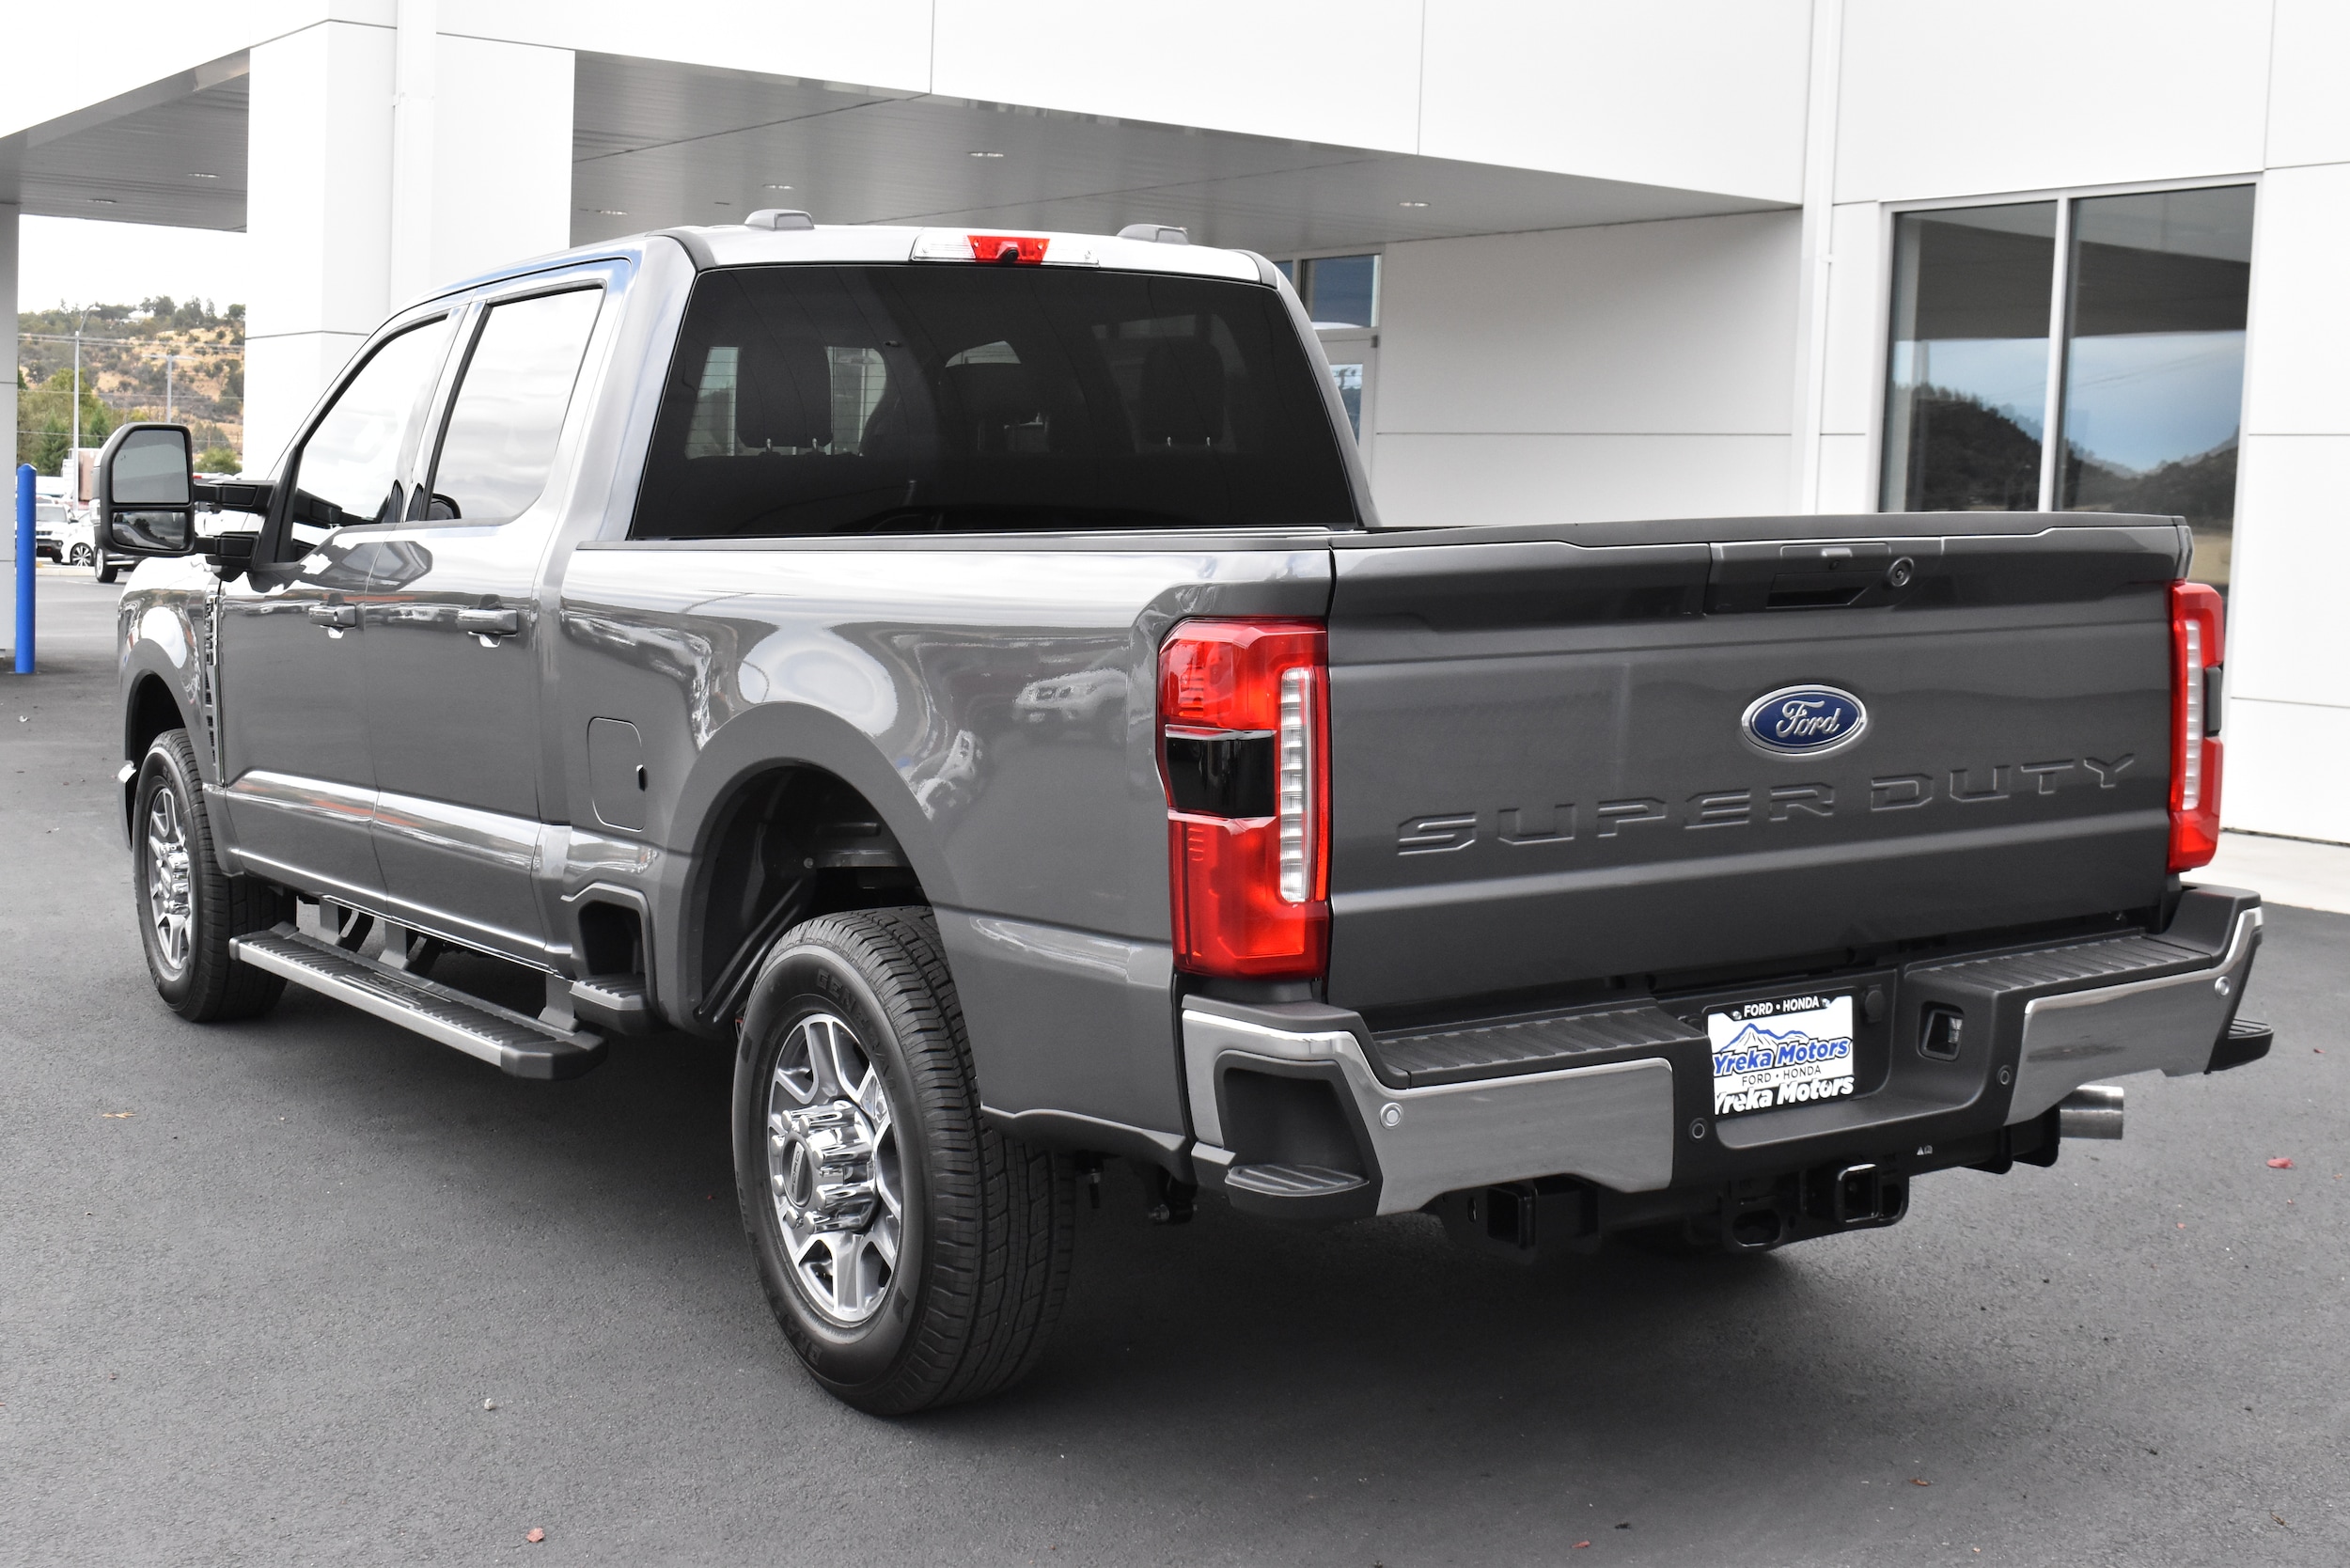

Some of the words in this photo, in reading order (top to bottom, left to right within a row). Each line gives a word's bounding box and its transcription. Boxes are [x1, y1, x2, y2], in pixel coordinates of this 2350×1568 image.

[1776, 699, 1842, 738] Ford
[1397, 782, 1835, 855] SUPER
[1871, 753, 2135, 811] DUTY
[1744, 1003, 1774, 1017] FORD
[1782, 996, 1820, 1012] HONDA
[1713, 1048, 1773, 1075] Yreka
[1777, 1038, 1850, 1065] Motors
[1742, 1072, 1772, 1087] FORD
[1783, 1064, 1822, 1080] HONDA
[1777, 1075, 1855, 1105] Motors
